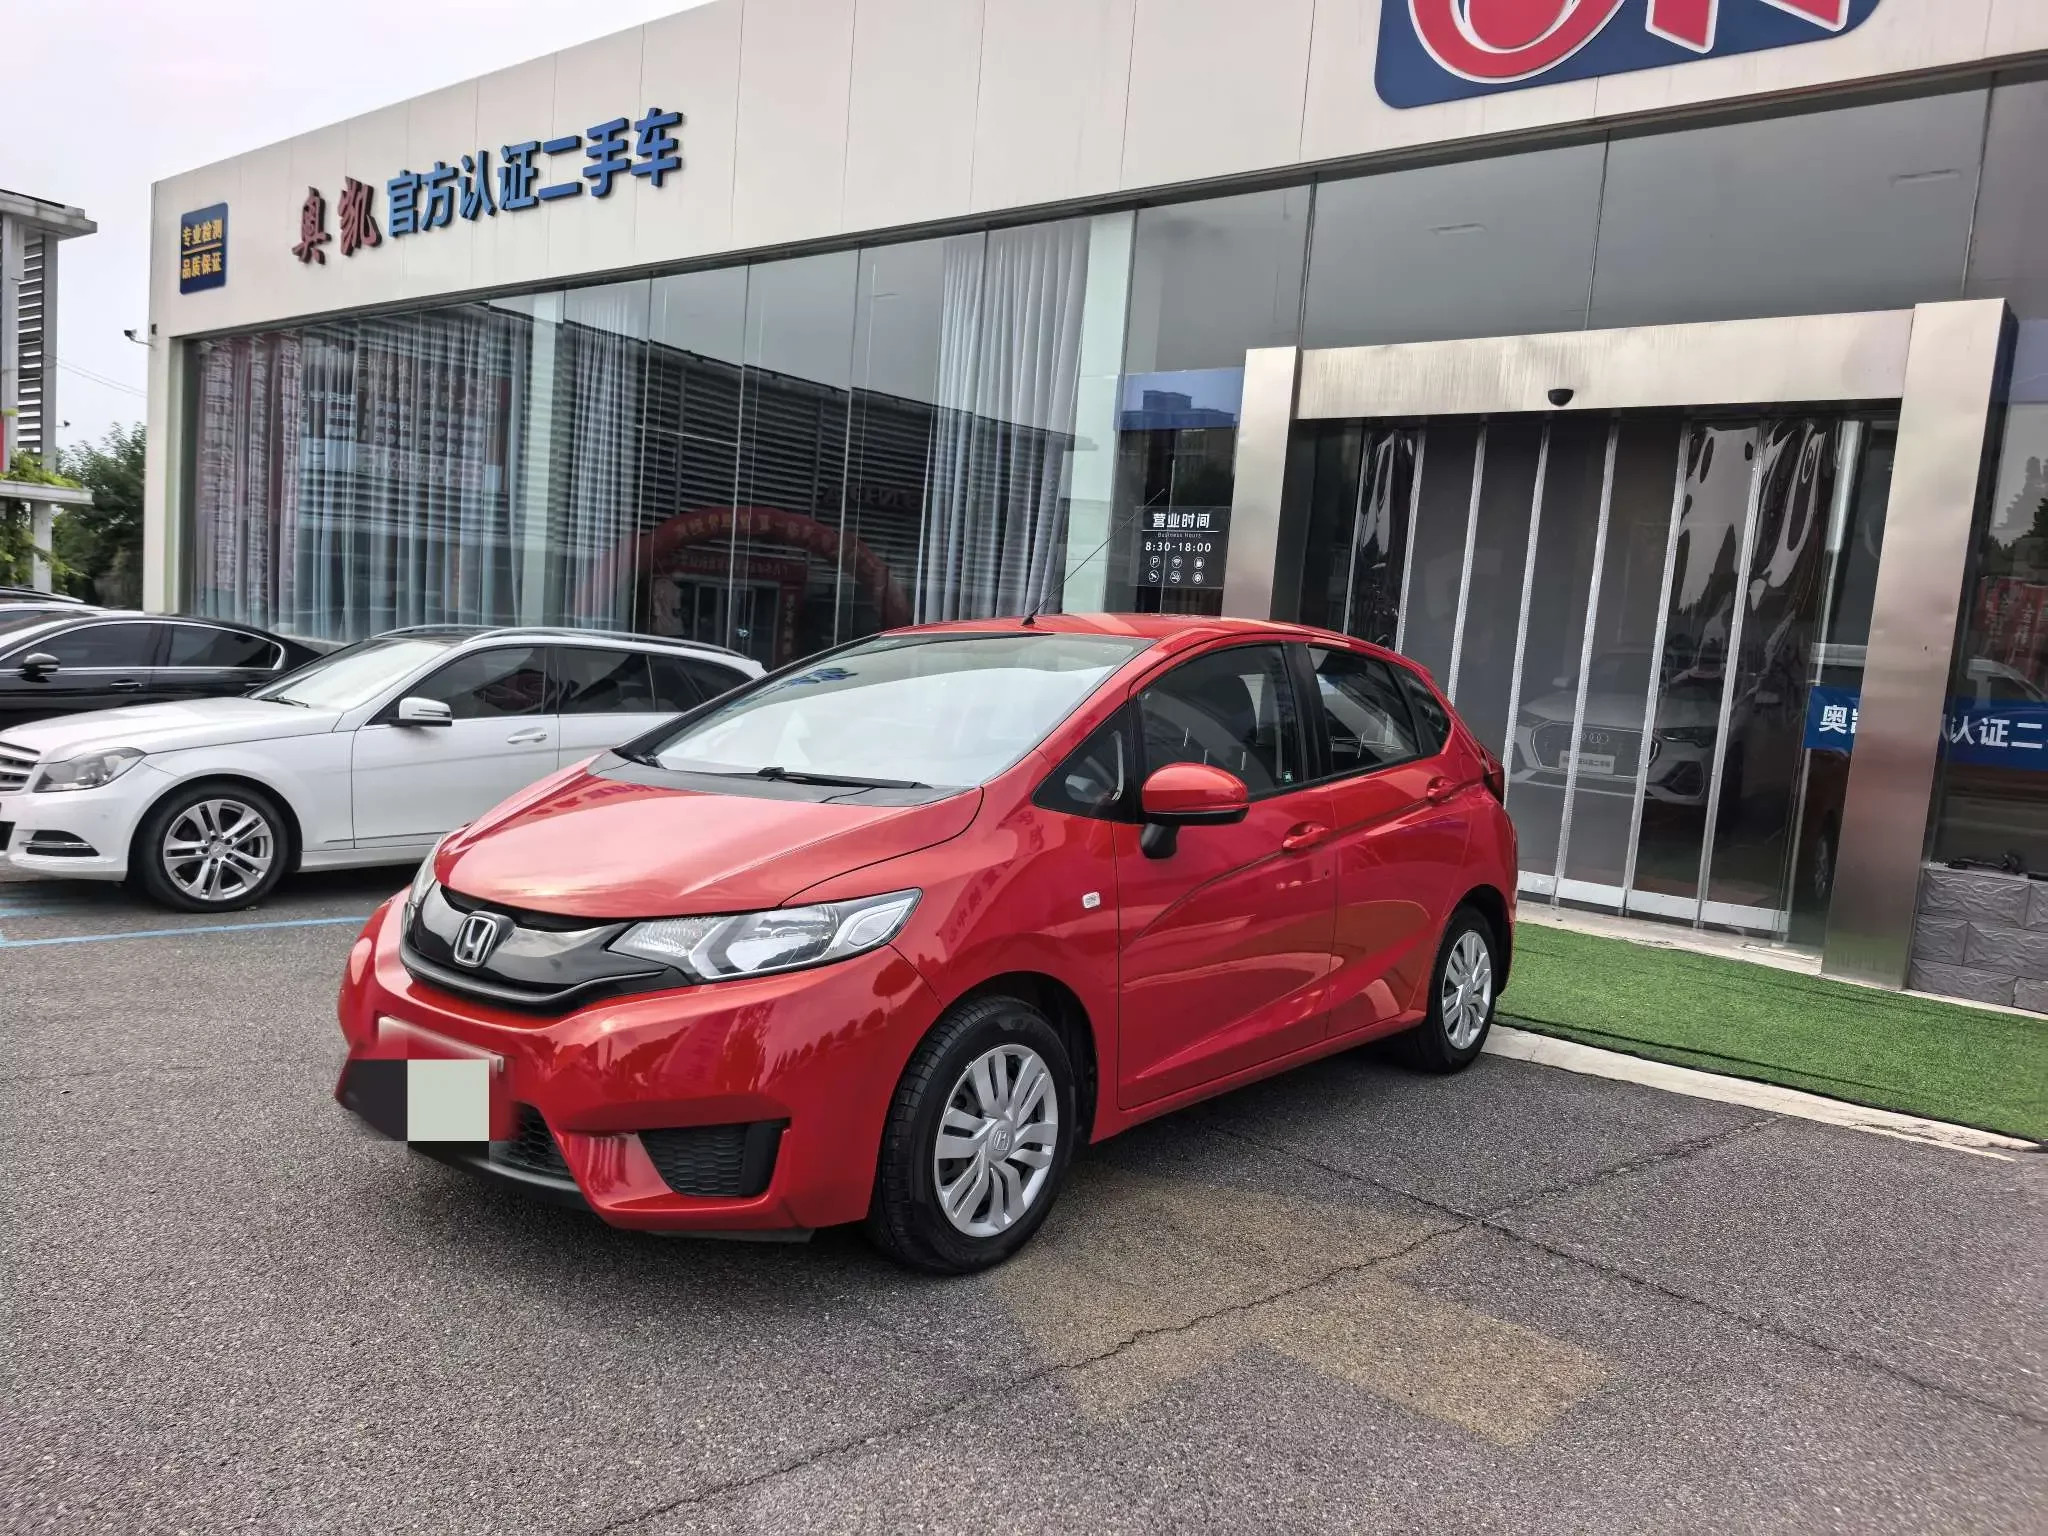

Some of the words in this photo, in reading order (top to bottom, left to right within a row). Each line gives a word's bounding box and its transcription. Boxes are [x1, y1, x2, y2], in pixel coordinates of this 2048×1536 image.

[291, 175, 383, 265] 奥凯
[387, 107, 683, 239] 官方认证二手车
[182, 218, 223, 247] 专业检测
[182, 252, 222, 279] 品质保证
[1152, 512, 1210, 529] 营业时间
[1145, 541, 1211, 552] 8:30-18:00
